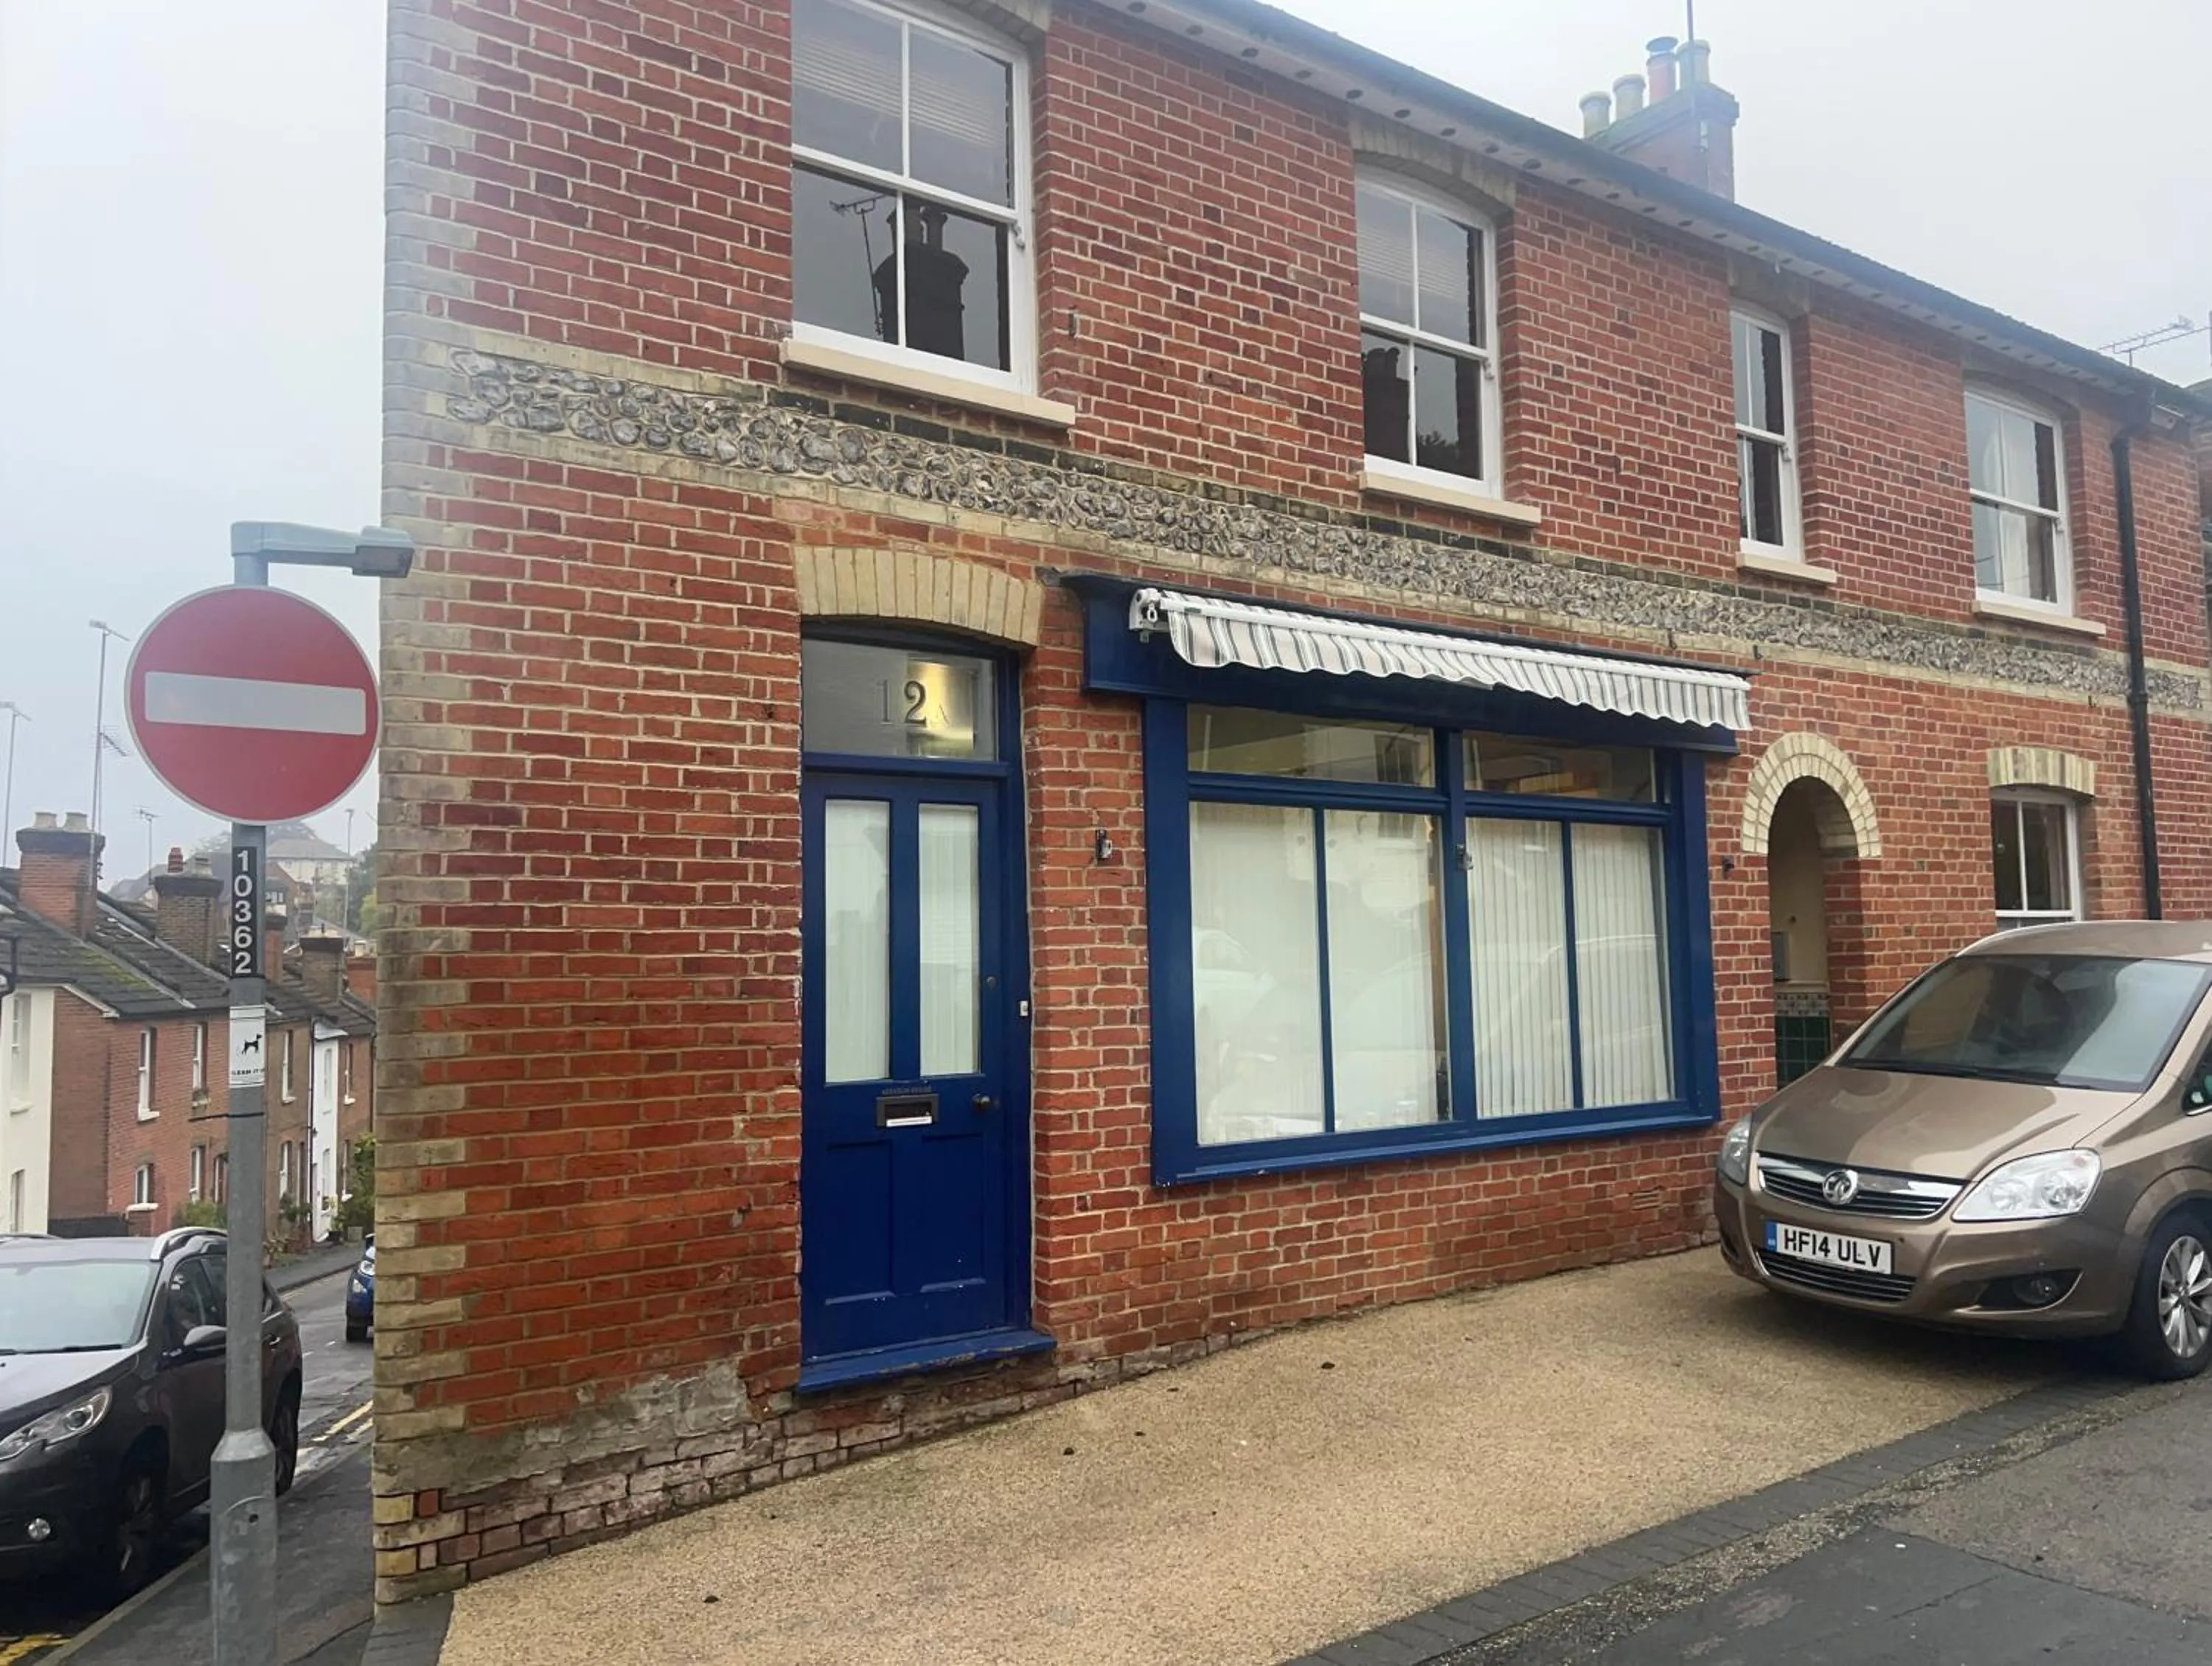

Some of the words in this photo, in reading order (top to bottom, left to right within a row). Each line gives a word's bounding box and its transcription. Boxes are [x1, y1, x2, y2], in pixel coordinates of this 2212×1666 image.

[234, 850, 252, 974] 10362
[1784, 1228, 1830, 1258] HF14
[1838, 1238, 1881, 1267] ULV
